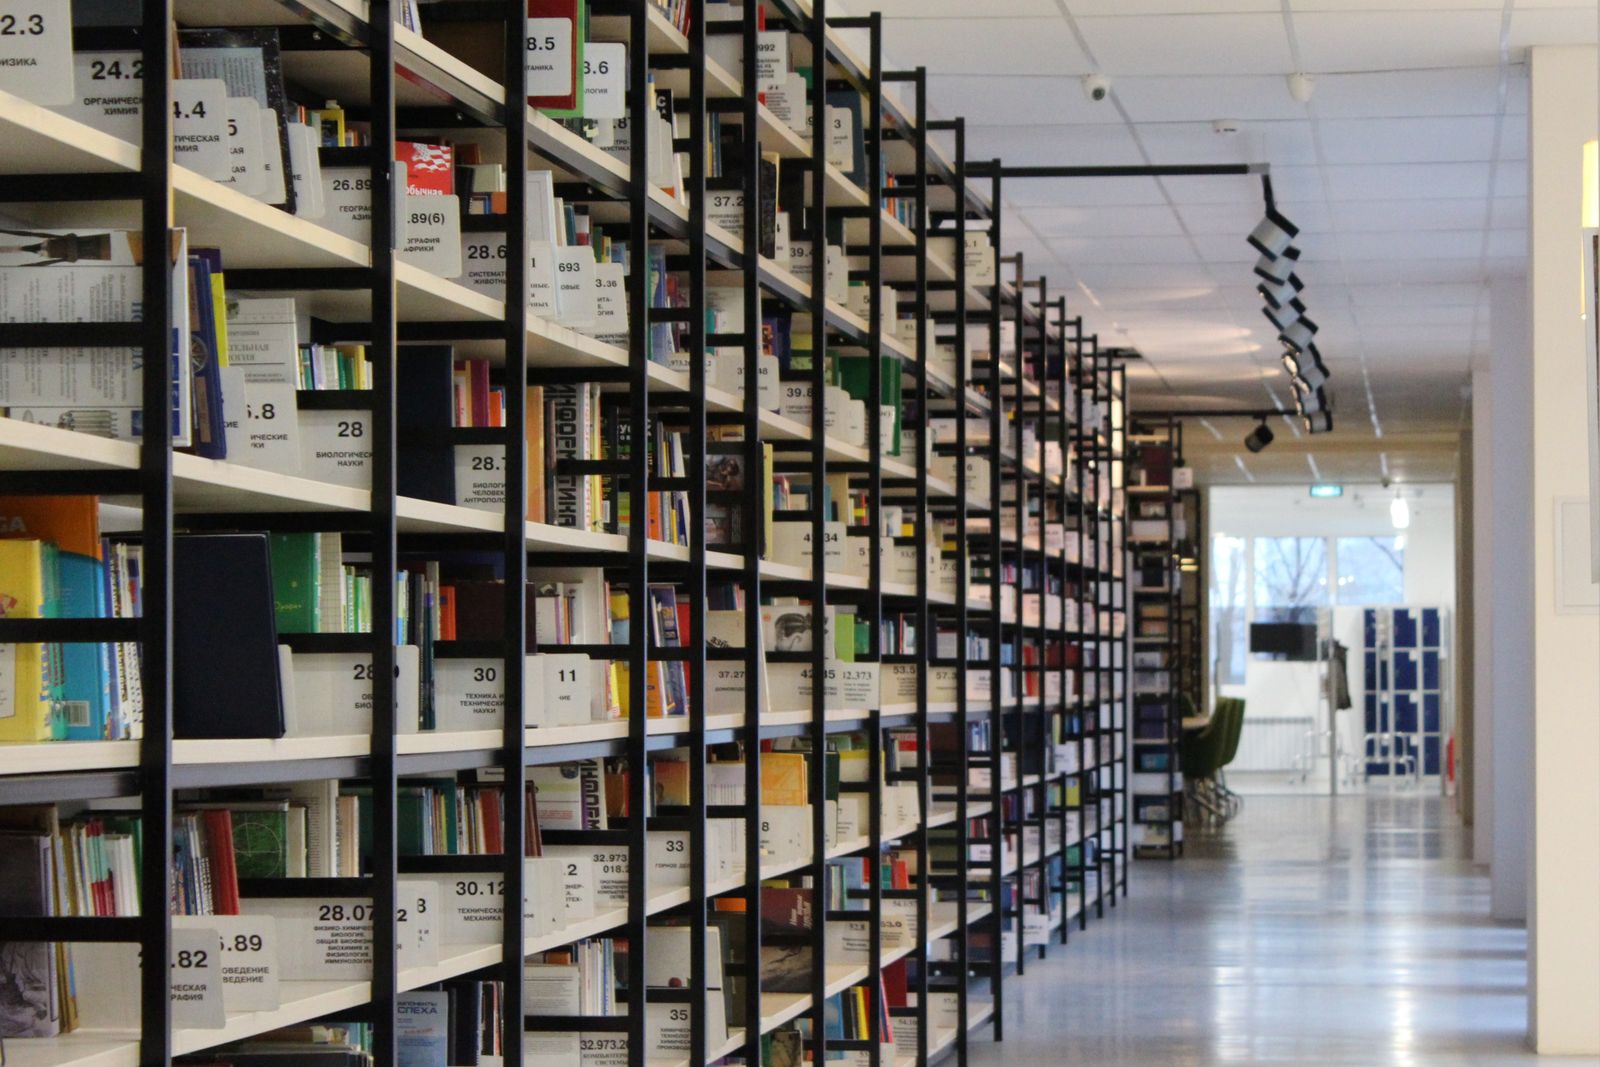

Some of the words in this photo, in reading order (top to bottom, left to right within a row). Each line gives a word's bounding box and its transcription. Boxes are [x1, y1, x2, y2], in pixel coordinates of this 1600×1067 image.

[103, 107, 139, 116] ХИМИЯ
[558, 262, 580, 273] 693
[337, 420, 364, 438] 28
[473, 667, 497, 682] 30
[465, 692, 497, 700] ТЕХНИКА
[665, 840, 685, 852] 33
[455, 881, 505, 896] 30.12
[669, 1008, 689, 1021] 35
